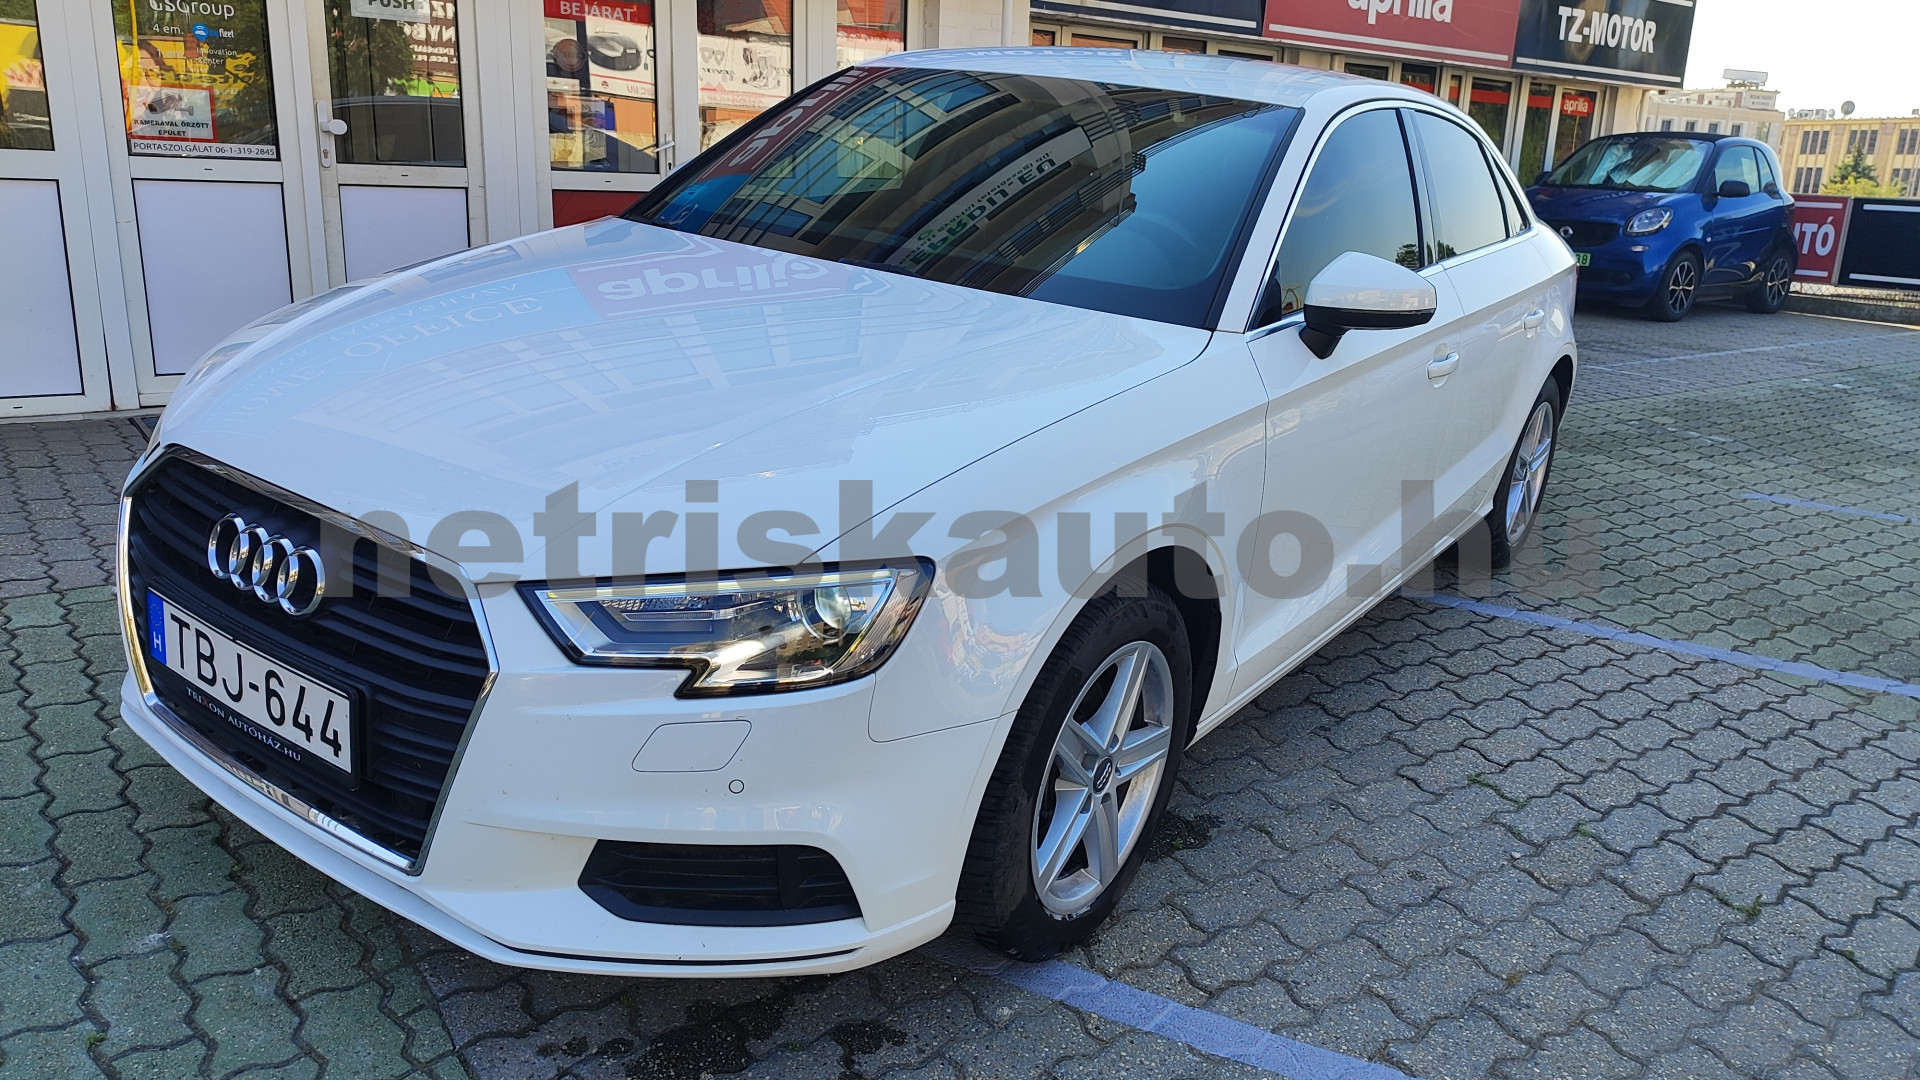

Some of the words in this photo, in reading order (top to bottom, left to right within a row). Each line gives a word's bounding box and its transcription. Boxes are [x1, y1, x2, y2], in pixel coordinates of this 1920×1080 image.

[560, 1, 634, 21] BEJÁRAT
[153, 23, 160, 32] 4
[1558, 5, 1657, 54] TZ-MOTOR
[1563, 98, 1589, 113] aprilia
[133, 141, 213, 153] PORTASZOLGÁLAT
[1794, 216, 1835, 257] TÓ
[153, 633, 162, 653] H
[170, 612, 342, 759] TBJ-644
[186, 686, 226, 719] TRIXON
